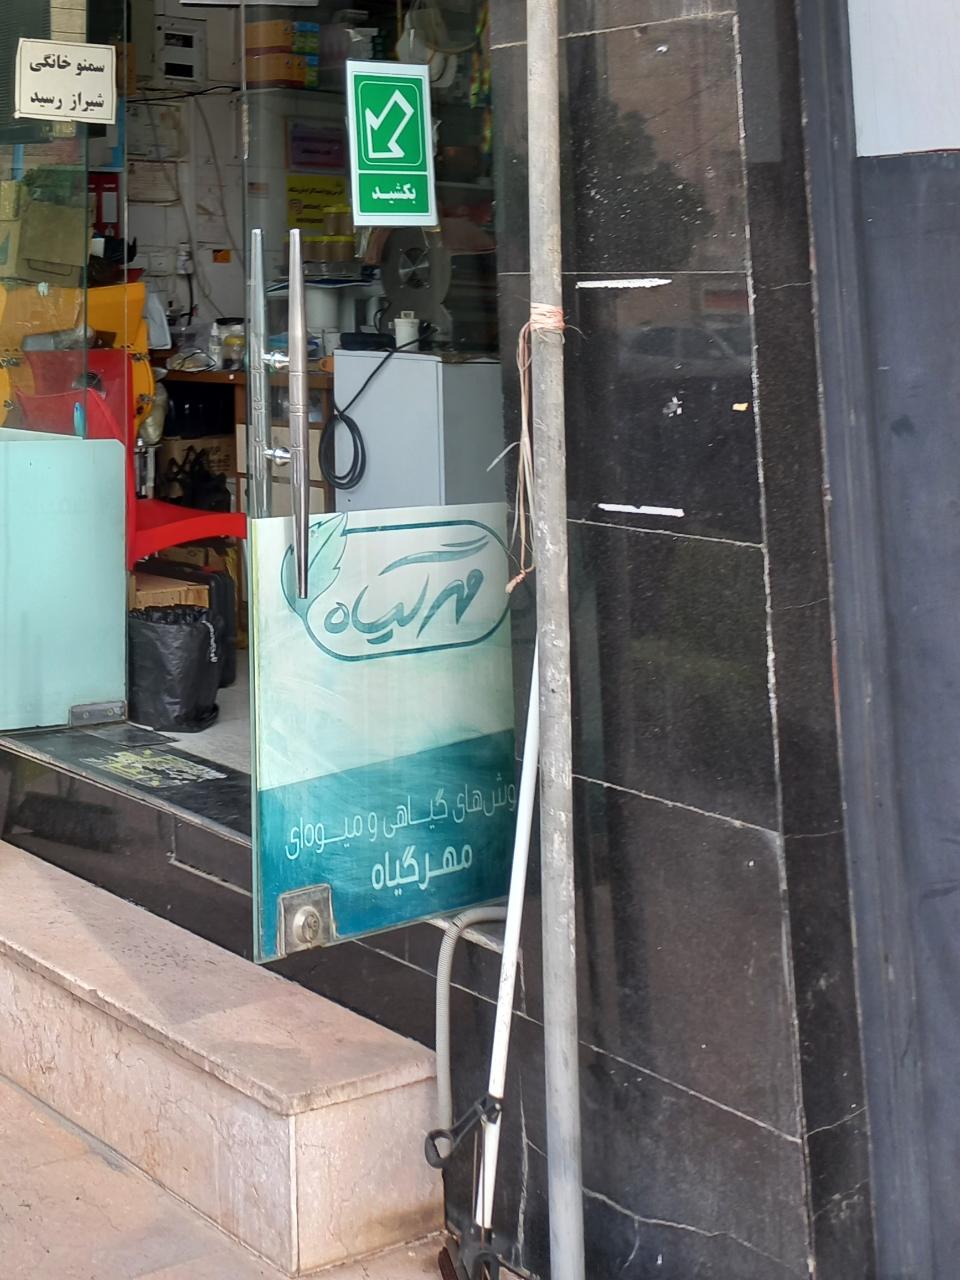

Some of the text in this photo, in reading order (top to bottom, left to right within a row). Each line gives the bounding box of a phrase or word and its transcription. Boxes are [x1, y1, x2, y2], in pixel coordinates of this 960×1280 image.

[29, 52, 105, 76] سمنو خانگی
[29, 90, 105, 112] شیراز رسید
[371, 182, 417, 205] بکشید
[367, 811, 379, 843] و
[383, 787, 449, 839] گیاهی
[371, 843, 474, 897] مهرگیاه
